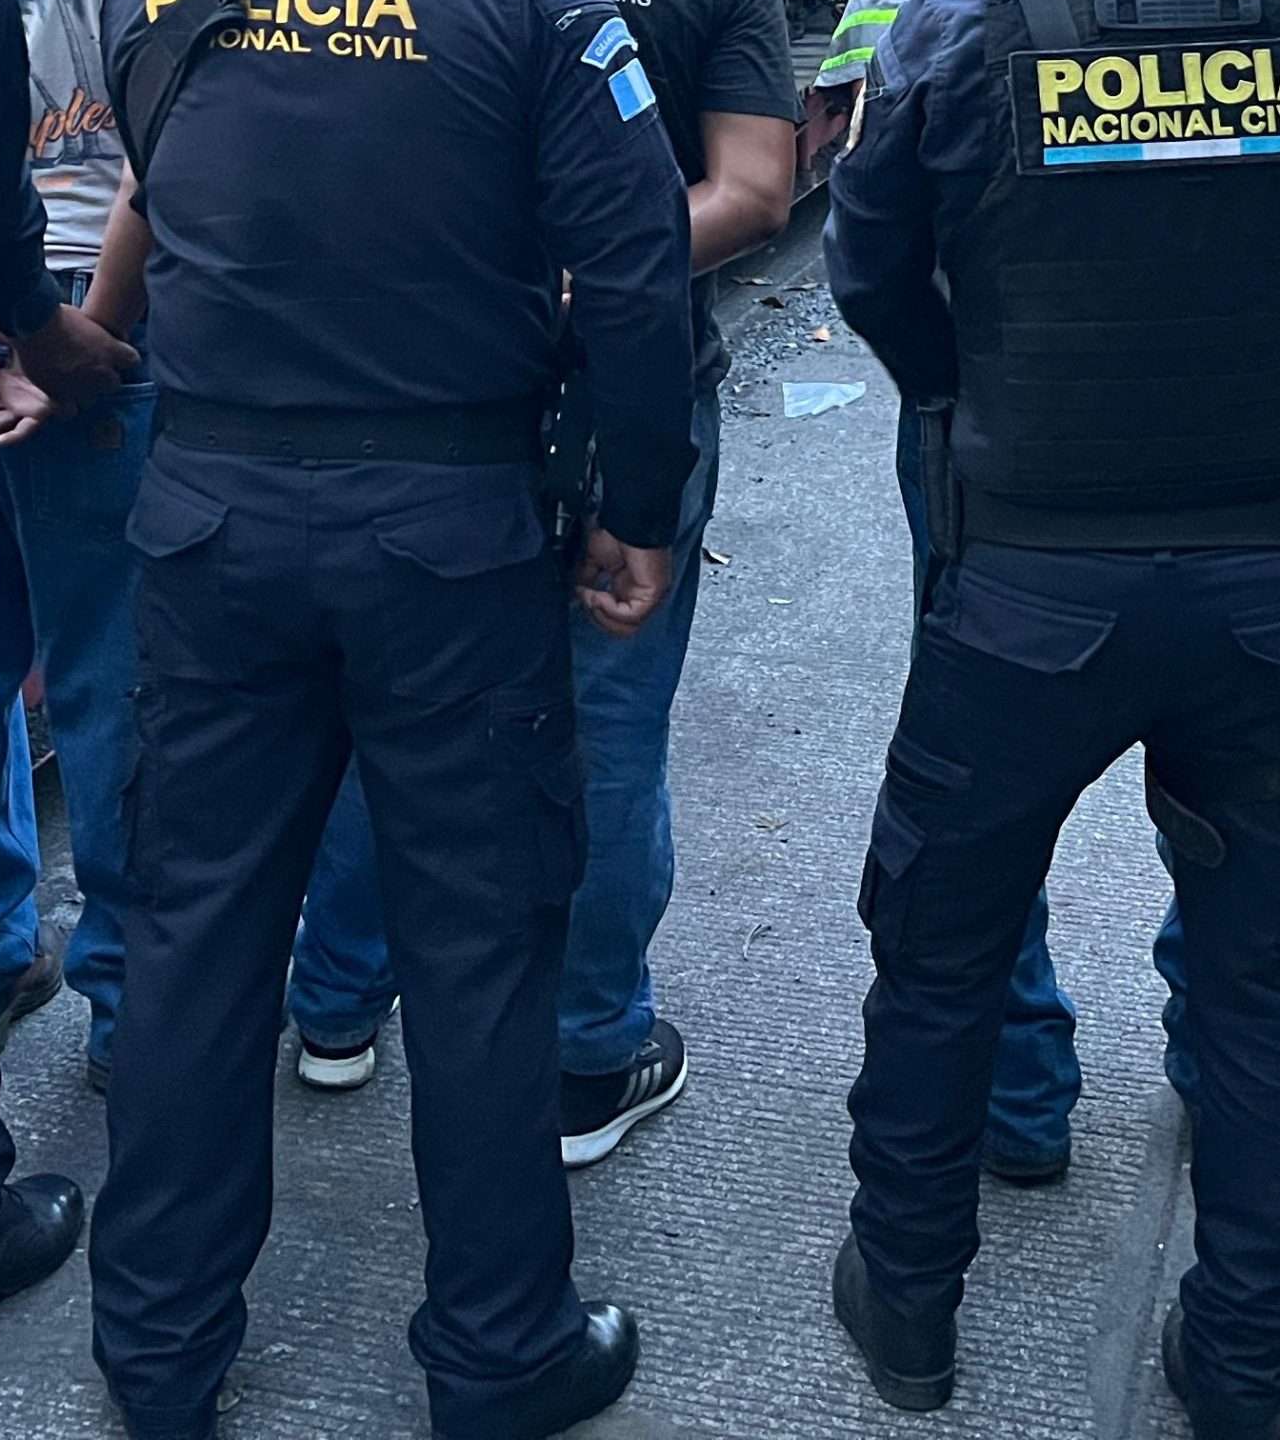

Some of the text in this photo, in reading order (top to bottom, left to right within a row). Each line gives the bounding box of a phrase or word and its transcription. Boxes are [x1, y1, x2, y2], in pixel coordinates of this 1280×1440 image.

[327, 31, 428, 61] CIVIL
[30, 86, 118, 160] ples
[1042, 110, 1233, 145] NACIONAL
